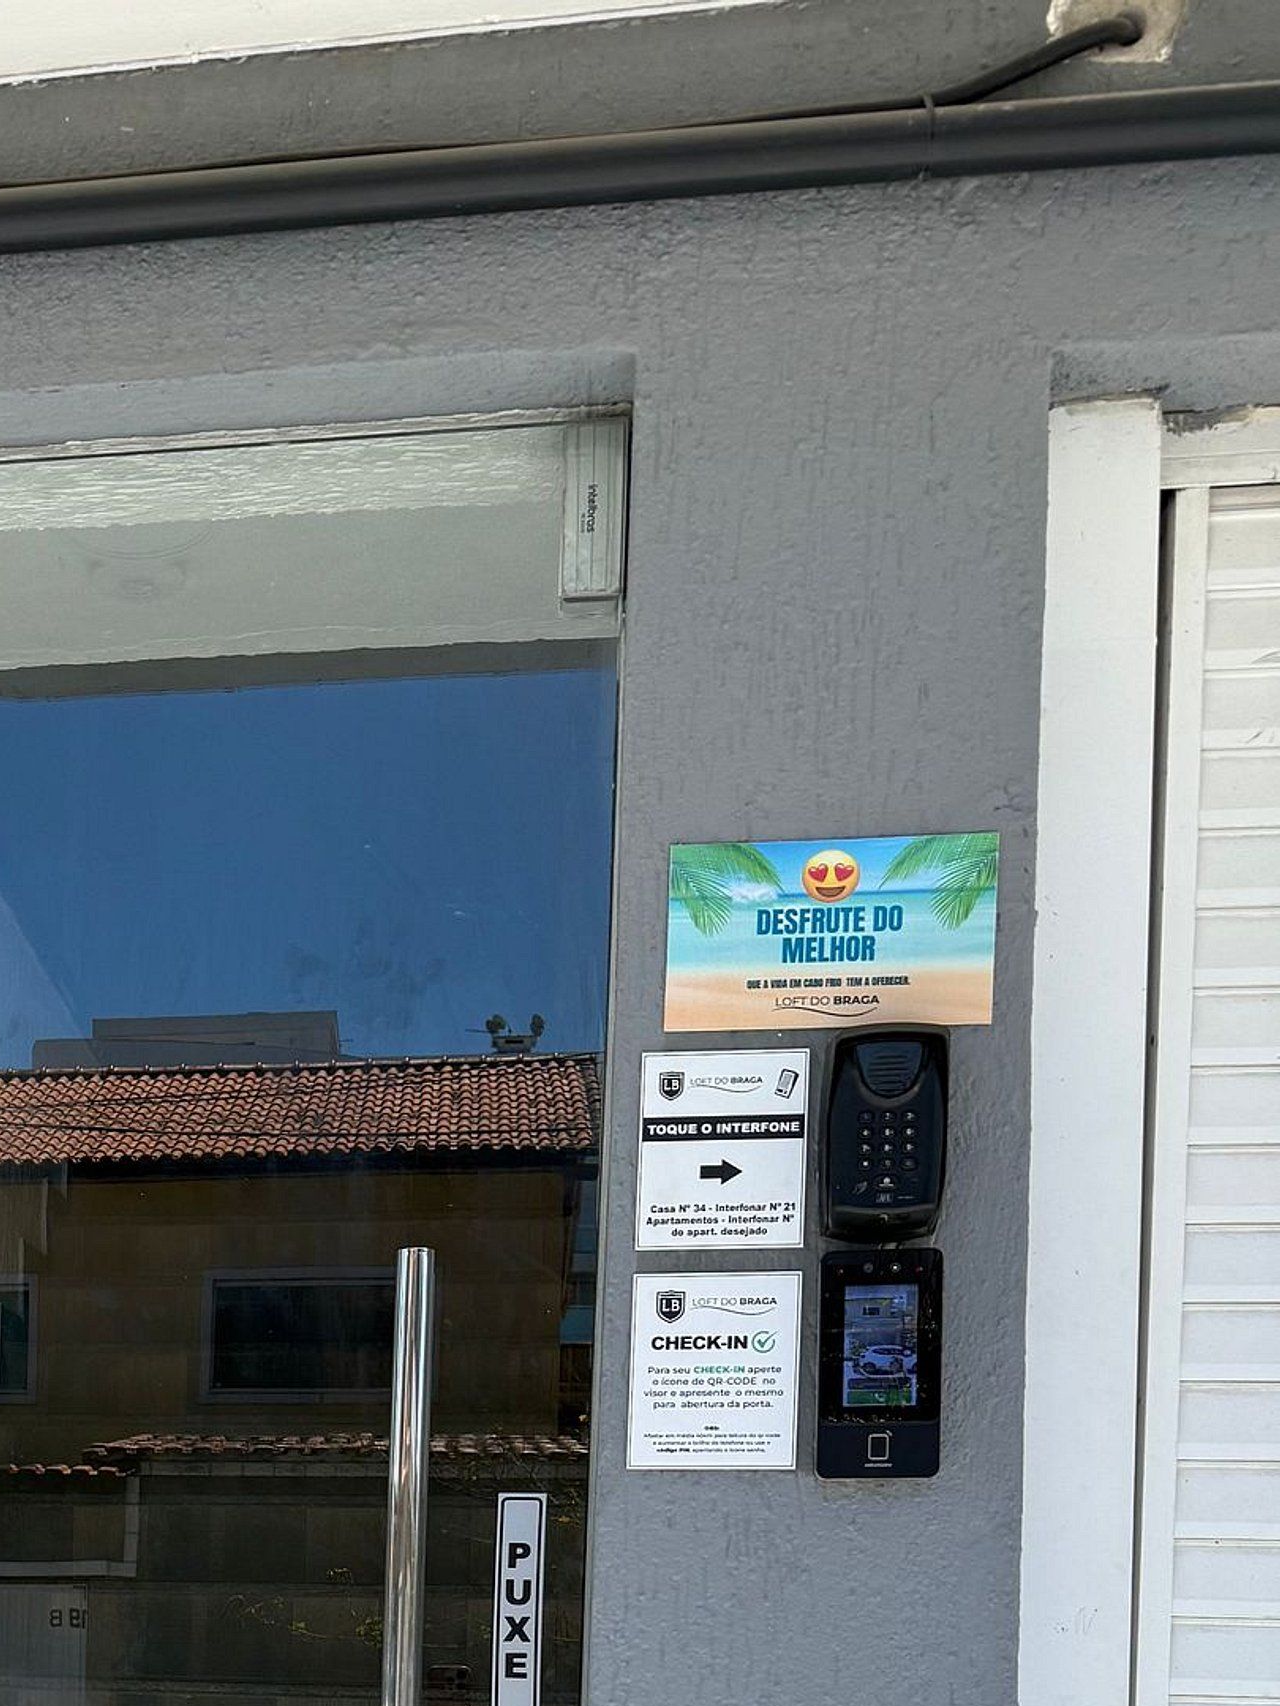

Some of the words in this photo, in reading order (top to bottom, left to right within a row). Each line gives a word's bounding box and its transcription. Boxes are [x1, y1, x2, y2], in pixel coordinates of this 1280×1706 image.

[757, 906, 865, 935] DESFRUTE
[873, 905, 903, 931] DO
[782, 936, 875, 963] MELHOR
[746, 979, 761, 989] QUE
[846, 976, 863, 987] TEM
[864, 976, 869, 986] A
[775, 996, 806, 1006] LOFT
[810, 995, 830, 1006] DO
[833, 995, 880, 1005] BRAGA
[663, 1079, 680, 1091] LB
[714, 1077, 729, 1085] DO
[730, 1076, 763, 1084] BRAGA
[647, 1123, 698, 1136] TOQUE
[701, 1123, 712, 1134] O
[716, 1121, 800, 1134] INTERFONE
[650, 1204, 676, 1213] Casa
[693, 1204, 706, 1213] 34
[715, 1203, 767, 1213] Interfonar
[783, 1202, 796, 1211] 21
[646, 1216, 719, 1227] Apartamentos
[728, 1214, 780, 1224] Interfonar
[671, 1228, 684, 1236] do
[686, 1228, 718, 1238] apart.
[720, 1227, 768, 1238] desejado
[662, 1299, 681, 1312] LB
[692, 1298, 718, 1306] LOFT
[720, 1297, 737, 1306] DO
[739, 1297, 778, 1305] BRAGA
[651, 1335, 748, 1350] CHECK-IN
[648, 1366, 670, 1374] Para
[693, 1365, 746, 1374] CHECK-IN
[747, 1366, 782, 1375] aperte
[691, 1377, 705, 1386] de
[707, 1377, 757, 1387] QR-CODE
[643, 1389, 667, 1397] visor
[679, 1389, 731, 1399] apresente
[744, 1389, 784, 1397] mesmo
[653, 1401, 676, 1410] para
[680, 1400, 725, 1408] abertura
[727, 1400, 740, 1408] da
[742, 1400, 774, 1409] porta.
[503, 1542, 532, 1680] PUXE
